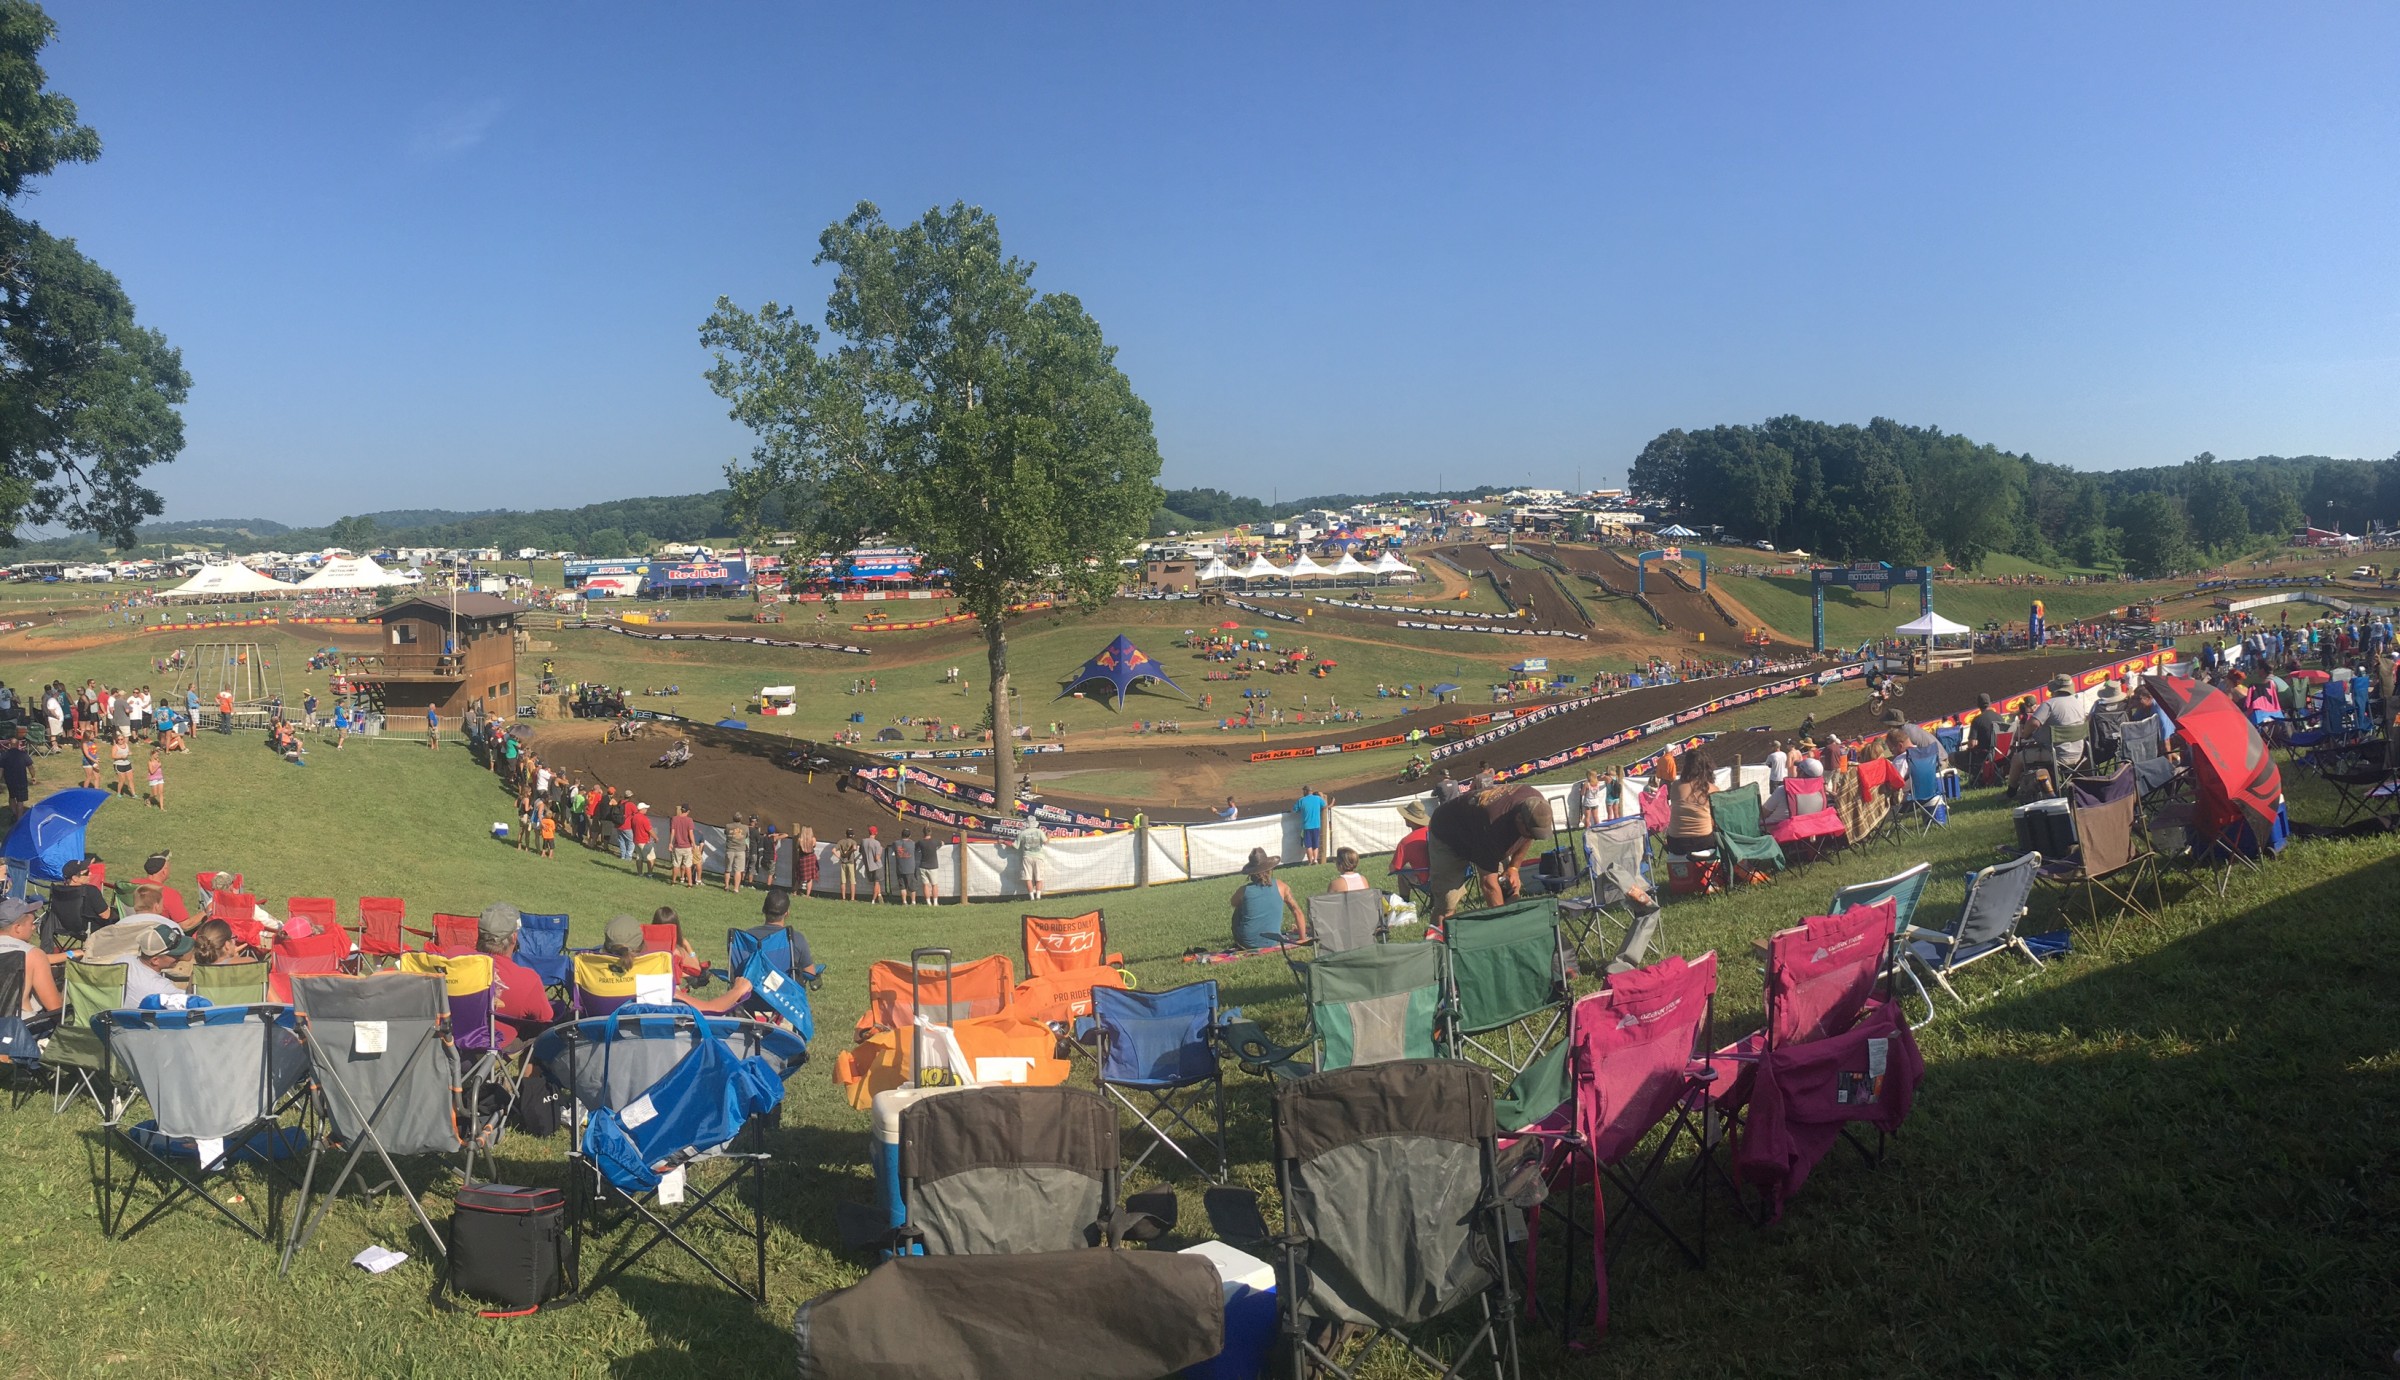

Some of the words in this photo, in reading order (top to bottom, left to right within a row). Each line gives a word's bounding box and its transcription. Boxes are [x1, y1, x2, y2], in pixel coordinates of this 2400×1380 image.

[1035, 922, 1048, 930] PRO
[1050, 922, 1076, 932] RIDERS
[1035, 932, 1094, 954] KTM
[1054, 992, 1068, 1002] PRO
